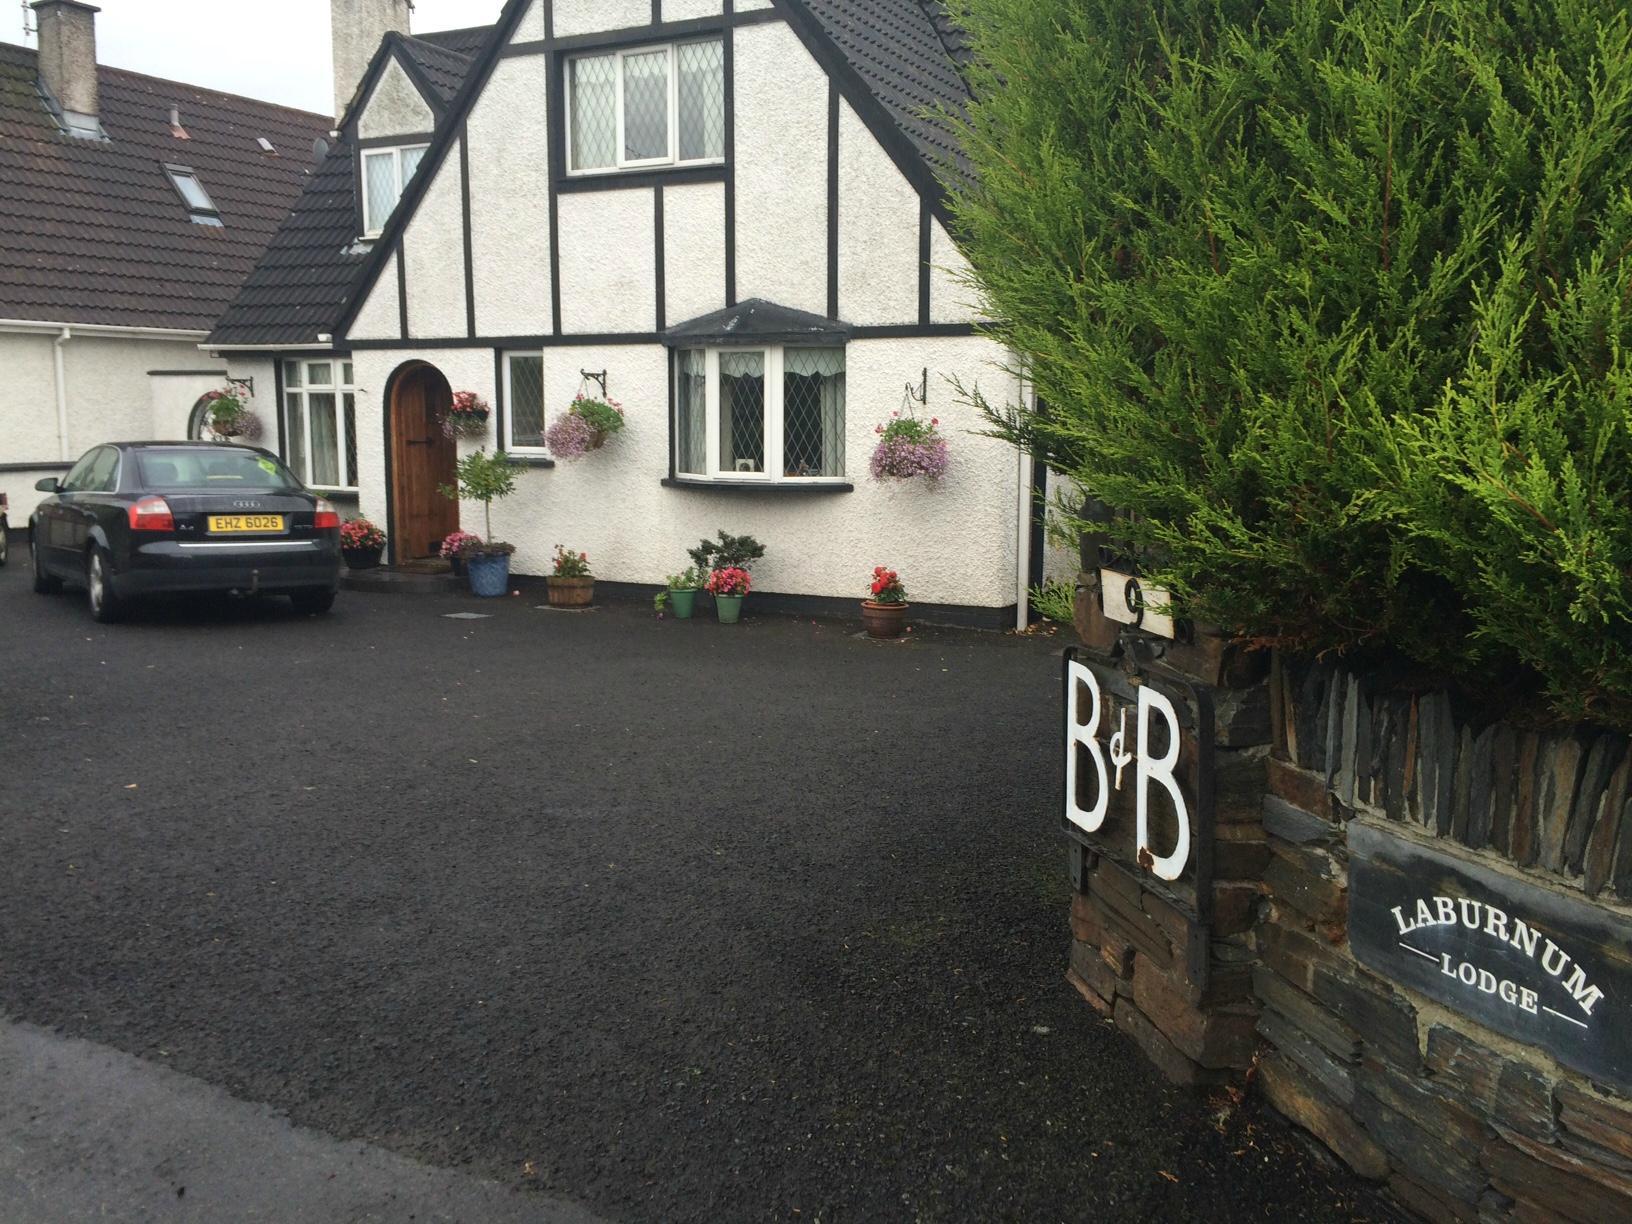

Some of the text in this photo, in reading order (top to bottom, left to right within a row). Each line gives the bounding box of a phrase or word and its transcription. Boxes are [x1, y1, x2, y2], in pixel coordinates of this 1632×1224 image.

[215, 517, 242, 529] EHZ
[244, 516, 279, 528] 6026
[1124, 577, 1144, 629] 9
[1390, 896, 1605, 1016] LABURNUM
[1440, 952, 1538, 1015] LODGE
